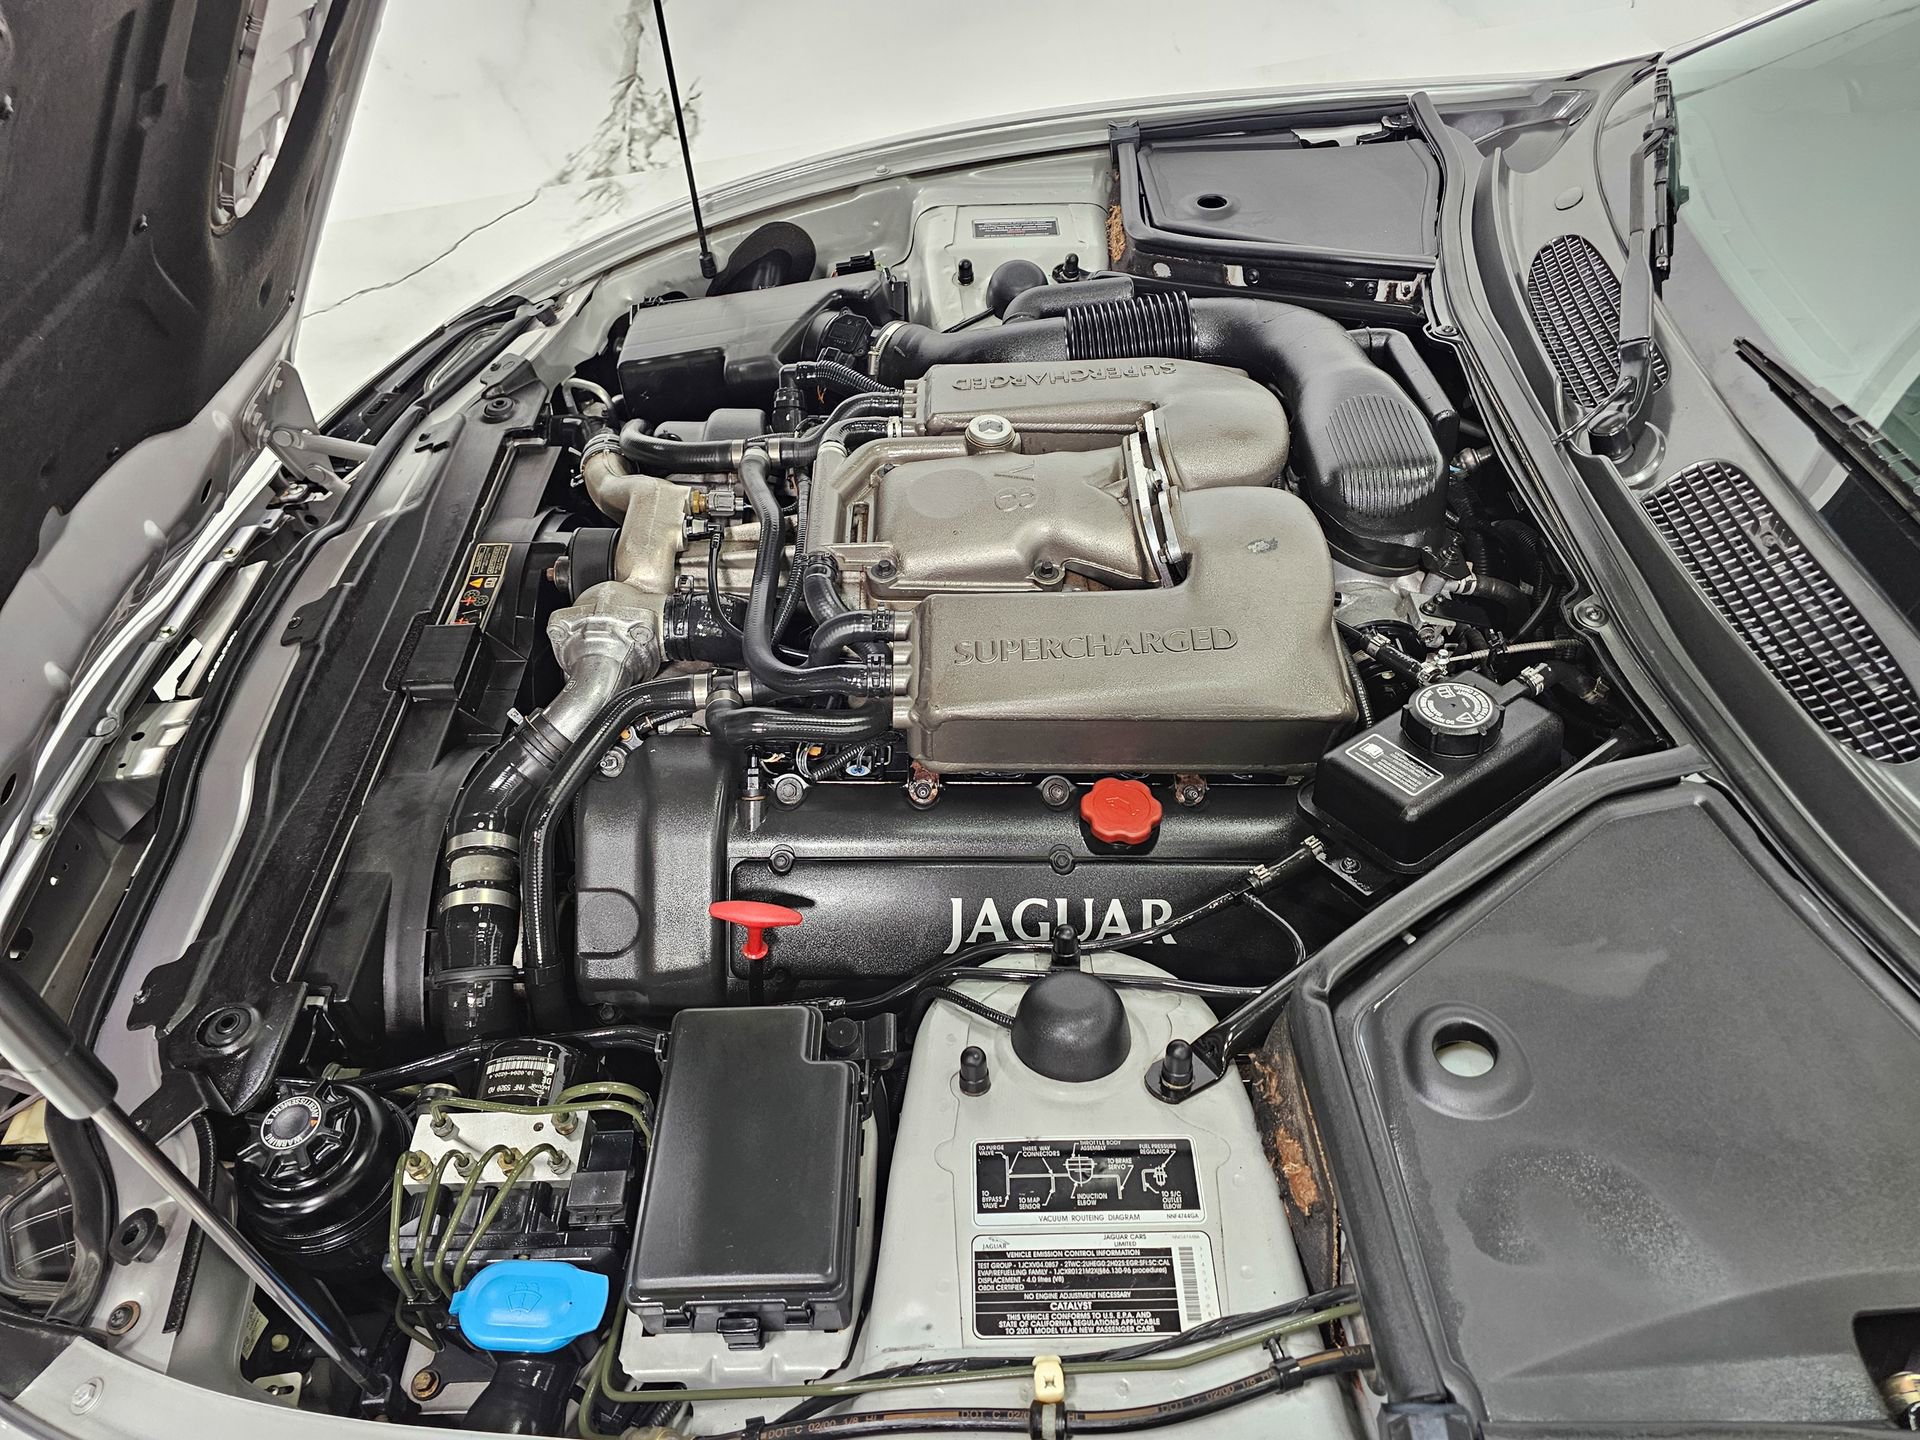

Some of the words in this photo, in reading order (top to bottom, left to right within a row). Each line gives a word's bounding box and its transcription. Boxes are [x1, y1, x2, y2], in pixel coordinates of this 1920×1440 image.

[952, 362, 1177, 391] SUPERCHARGED
[993, 459, 1036, 511] V8
[954, 626, 1238, 665] SUPERCHARGED
[943, 897, 1177, 955] JAGUAR
[265, 1133, 303, 1147] WARNING
[1071, 1214, 1104, 1222] ROUTEING
[977, 1269, 1027, 1277] EVAP/REFUELLING
[977, 1276, 1021, 1284] DISPLACEMENT
[1052, 1276, 1065, 1284] (V8)
[995, 1283, 1025, 1291] CERTIFIED
[1059, 1291, 1096, 1299] ADJUSTMENT
[1049, 1301, 1092, 1311] CATALYST
[998, 1320, 1018, 1328] STATE
[1018, 1320, 1029, 1328] OF
[1073, 1319, 1120, 1327] REGULATIONS
[1016, 1327, 1032, 1335] 2001
[1096, 1325, 1135, 1333] PASSENGER
[1161, 1401, 1184, 1413] DOT
[1192, 1397, 1200, 1406] C
[961, 1410, 984, 1419] DOT
[992, 1410, 1000, 1419] C
[1007, 1411, 1031, 1420] 02/0
[768, 1429, 788, 1439] DOT
[794, 1425, 803, 1434] C
[808, 1419, 837, 1432] 02/00
